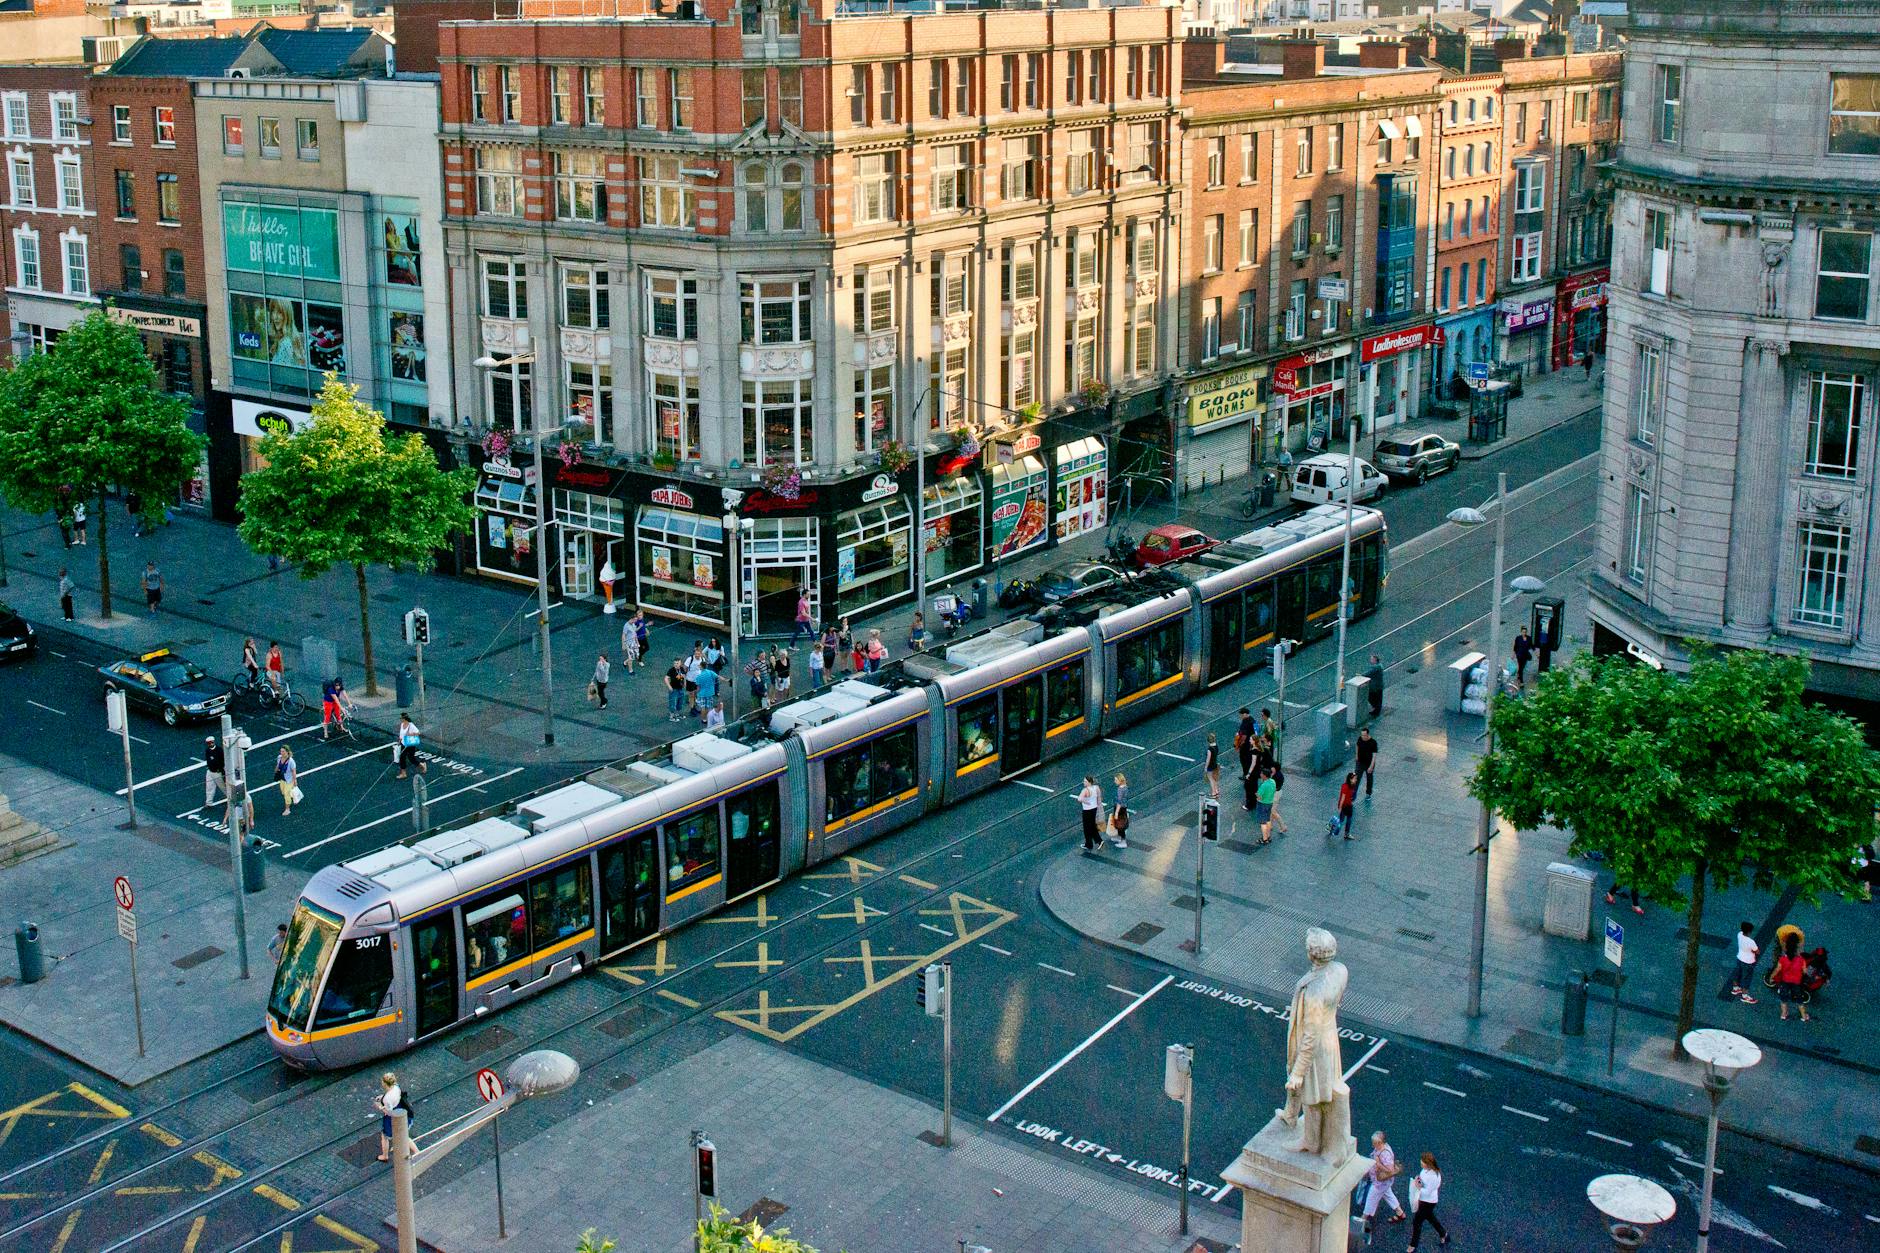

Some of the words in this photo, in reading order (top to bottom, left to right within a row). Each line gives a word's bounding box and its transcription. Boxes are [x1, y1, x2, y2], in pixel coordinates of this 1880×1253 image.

[249, 240, 286, 265] BRAVE
[127, 314, 175, 327] CONFECTIONERS
[239, 333, 259, 348] Keds
[1433, 328, 1440, 340] L
[1278, 370, 1293, 381] Café
[1193, 380, 1218, 394] BOOKS
[1225, 373, 1248, 385] BOOKS
[1275, 380, 1295, 391] Manila
[1206, 399, 1245, 419] WORMS
[259, 417, 288, 431] schuh
[652, 490, 669, 503] PAPA
[993, 507, 1004, 520] PAPA
[414, 750, 446, 763] RIGH
[443, 760, 484, 776] LOOK
[355, 936, 381, 950] 3017
[1175, 980, 1223, 998] RIGHT
[1219, 991, 1264, 1010] LOOK
[1338, 1027, 1380, 1046] LOO
[1015, 1119, 1063, 1142] LOOK
[1061, 1136, 1112, 1159] LEFT
[1125, 1159, 1173, 1183] LOOK
